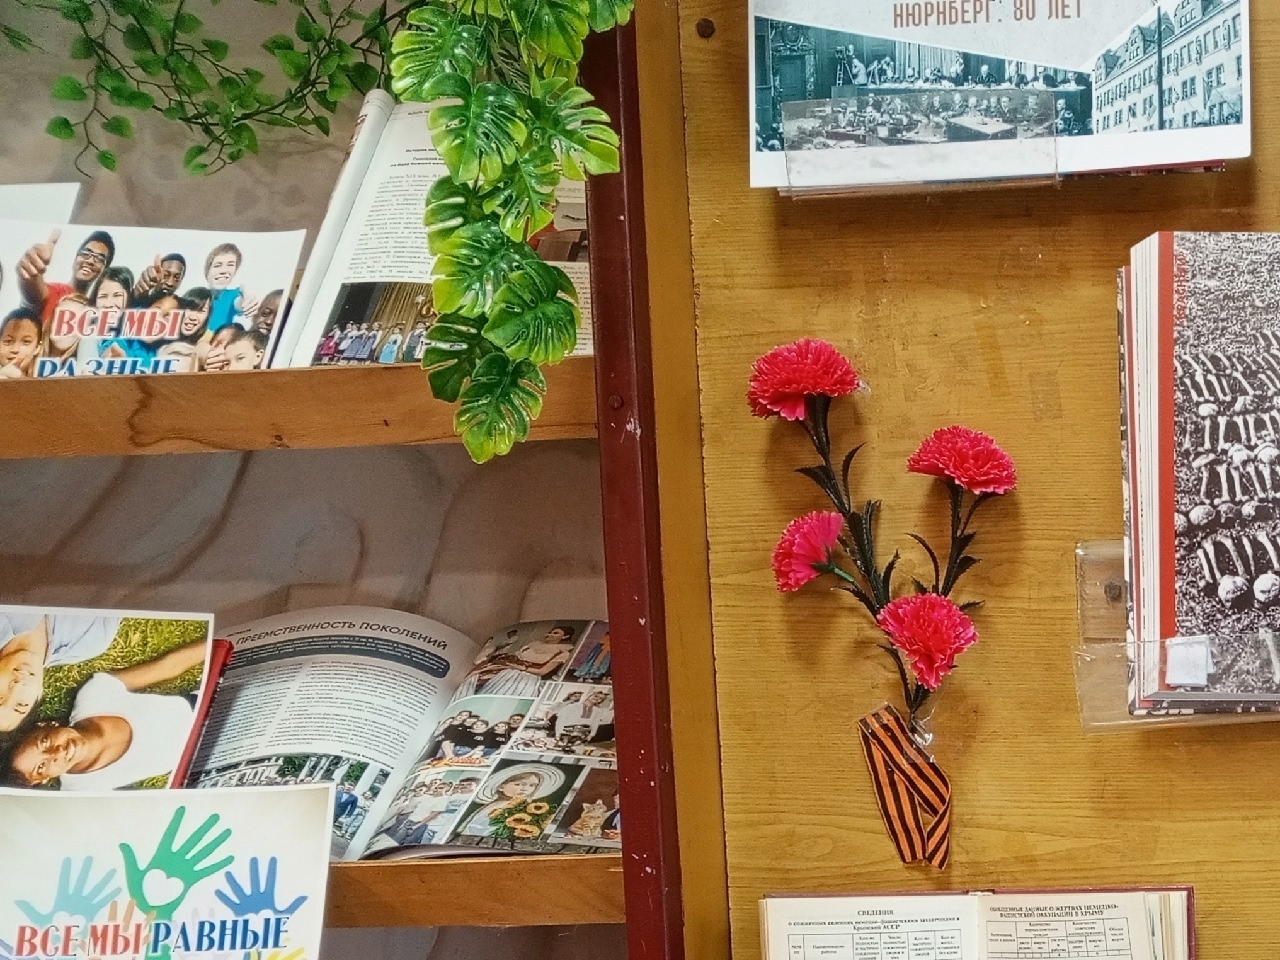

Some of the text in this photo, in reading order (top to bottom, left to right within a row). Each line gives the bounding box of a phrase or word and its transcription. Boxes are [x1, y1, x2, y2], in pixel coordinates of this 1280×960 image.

[1014, 0, 1035, 21] 80
[1048, 0, 1081, 20] ЛЕТ
[53, 309, 183, 337] ВСЕ МЫ
[236, 621, 448, 651] ПРЕЕМСТВЕННОСТЬ ПОКОЛЕНИЙ
[15, 916, 290, 957] ВСЕ МЫ РАВНЫЕ
